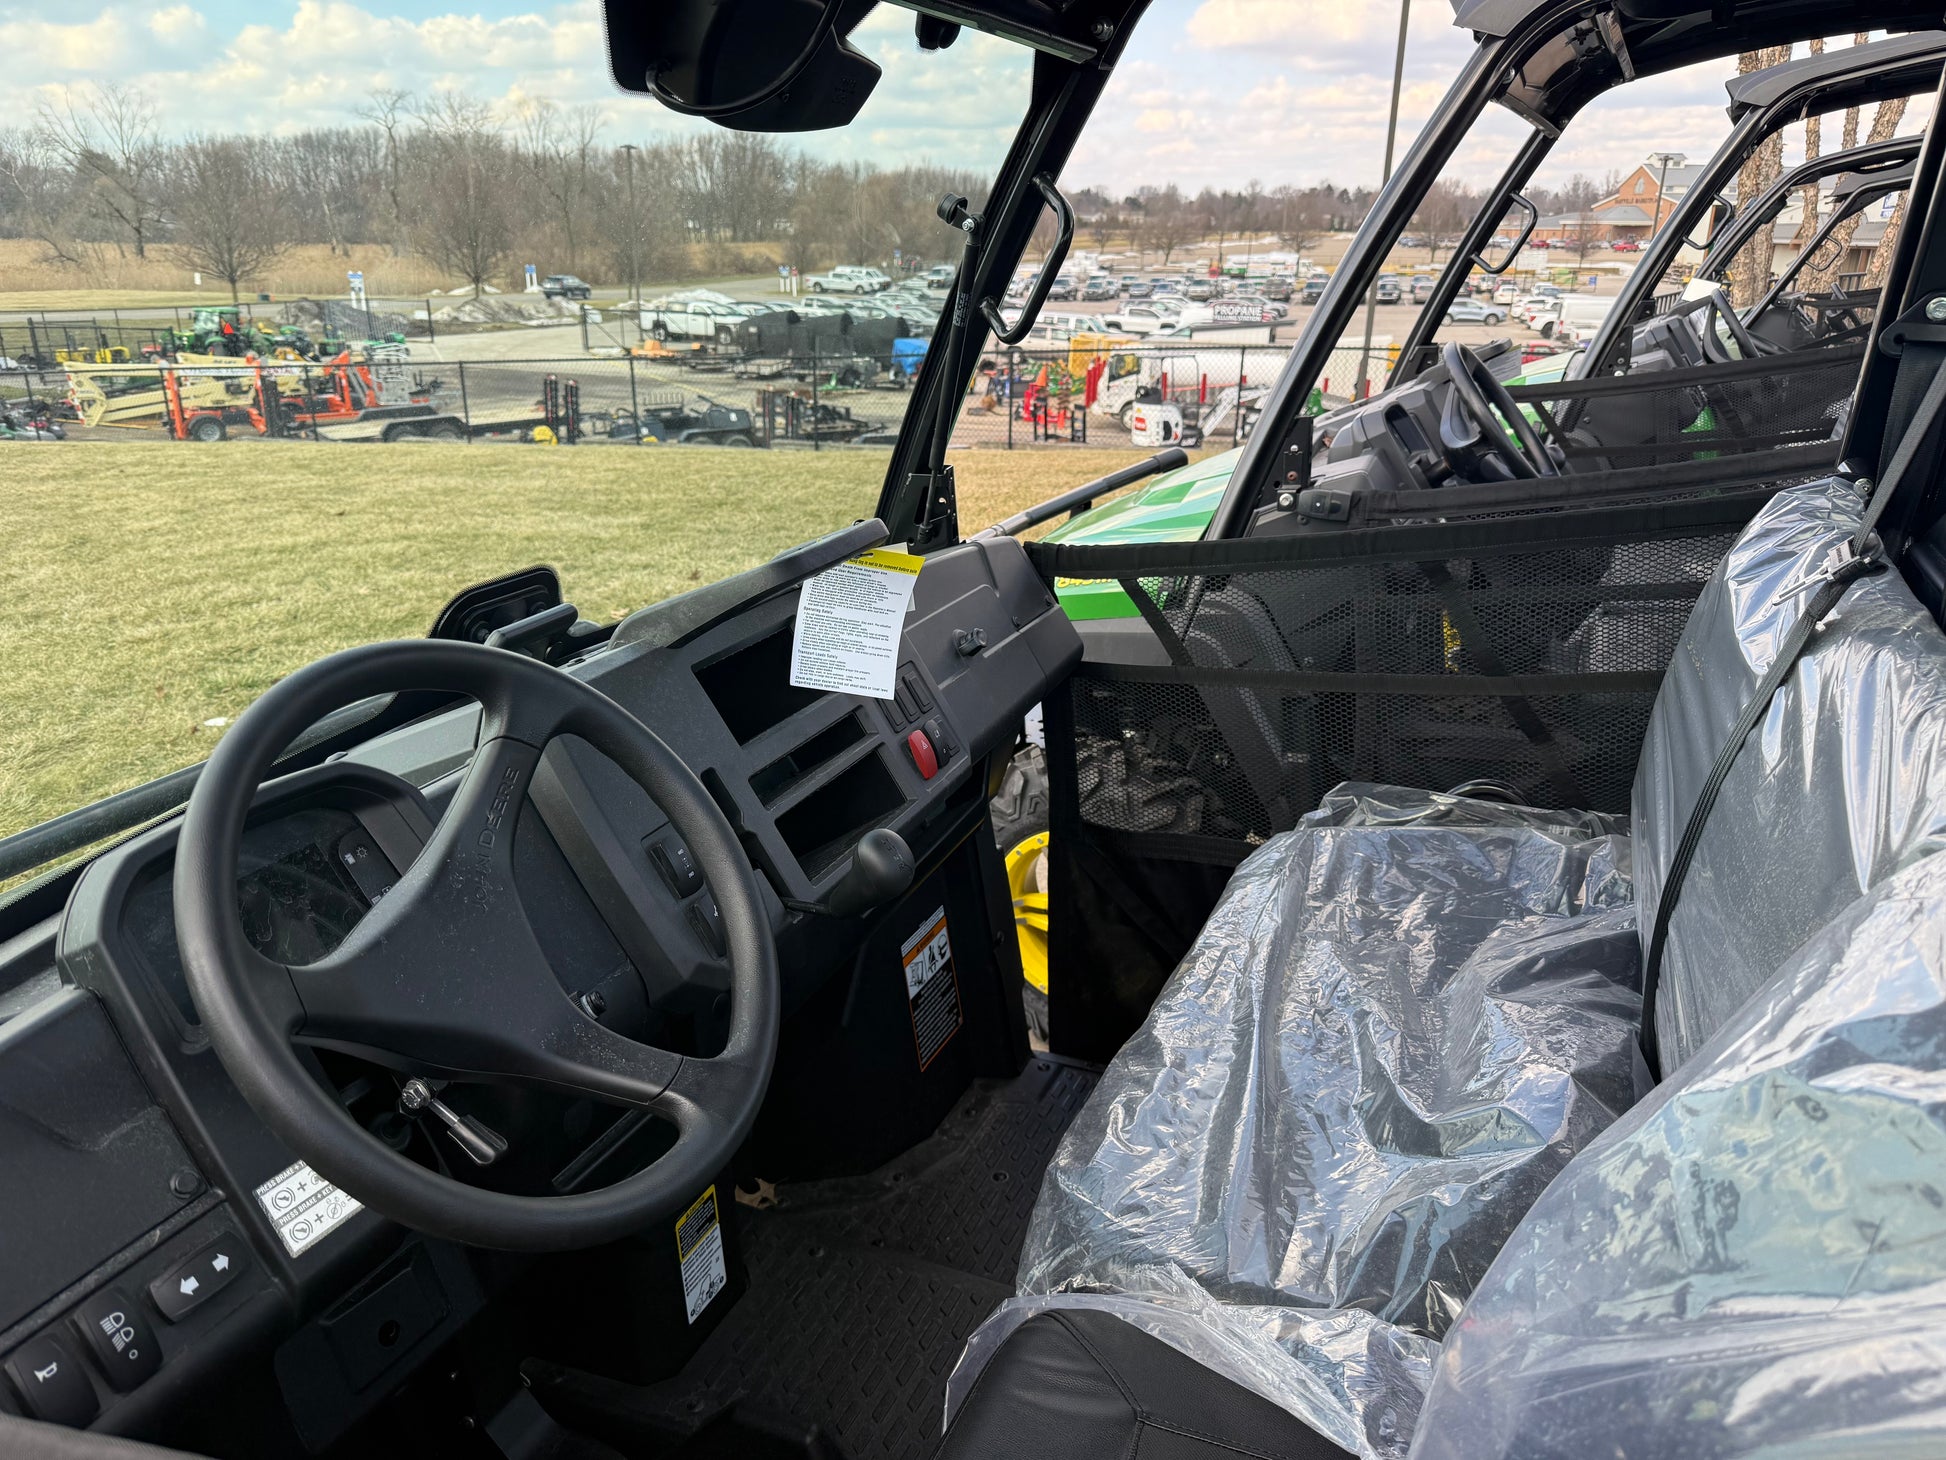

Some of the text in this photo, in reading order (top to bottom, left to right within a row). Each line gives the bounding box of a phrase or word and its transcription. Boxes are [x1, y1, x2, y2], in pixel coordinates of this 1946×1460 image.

[1215, 305, 1262, 316] PROPANE
[478, 766, 520, 848] DEERE
[256, 1178, 277, 1196] PRESS
[276, 1168, 295, 1184] BRAKE
[279, 1209, 300, 1226] PRESS
[298, 1199, 318, 1214] BRAKE
[322, 1185, 334, 1197] KEY
